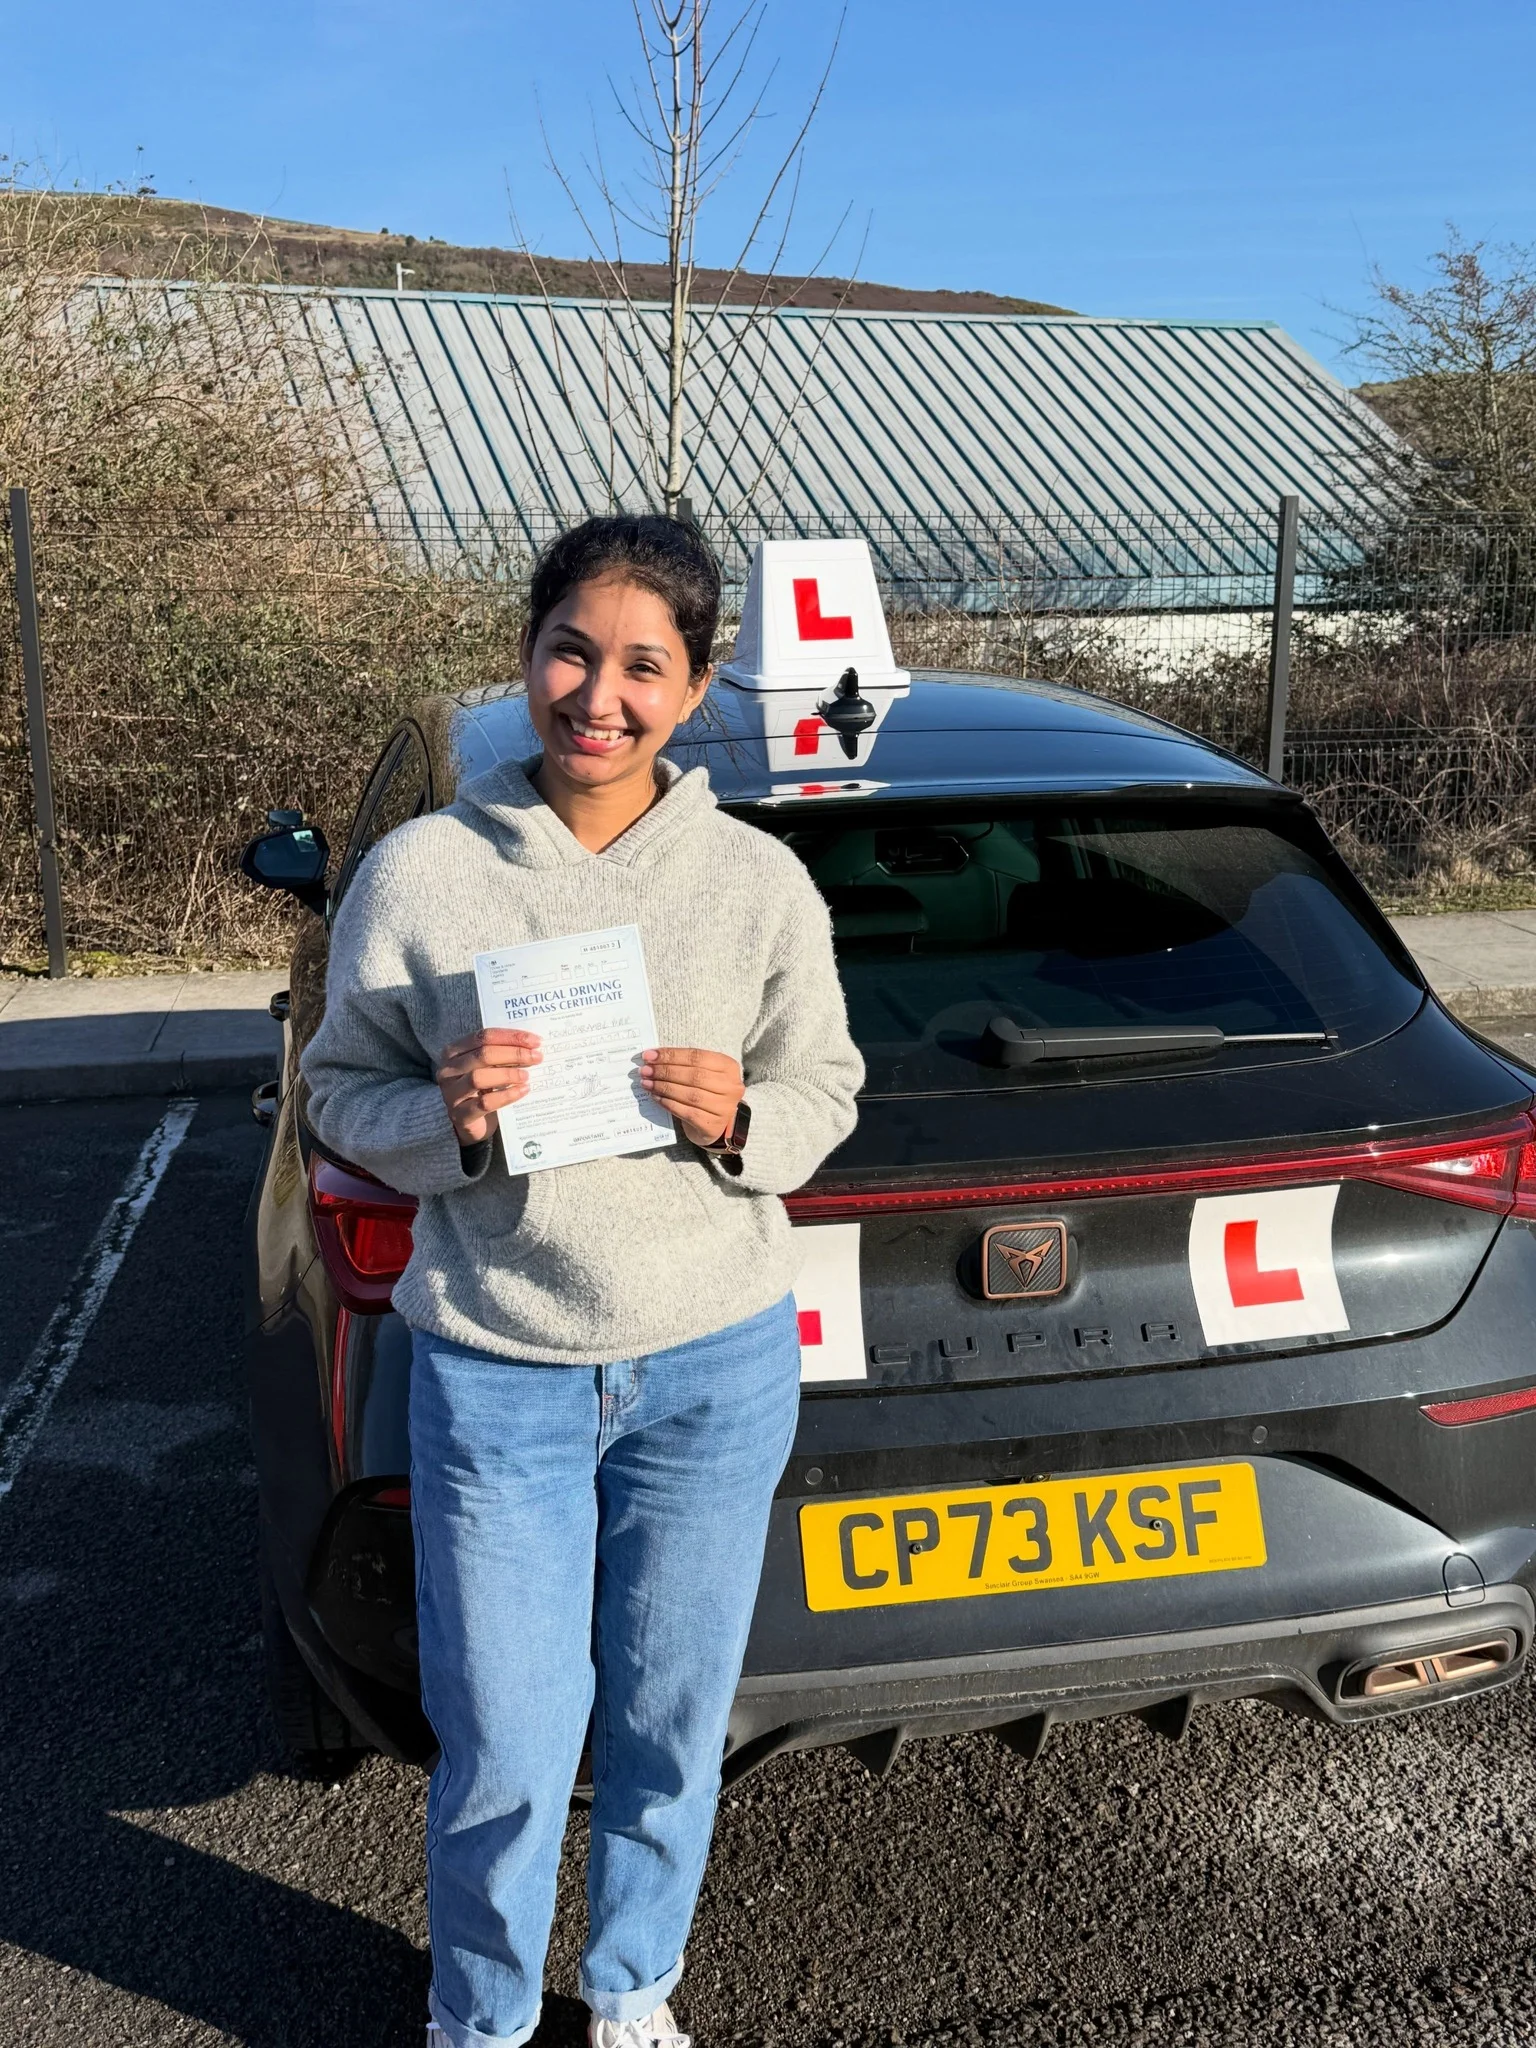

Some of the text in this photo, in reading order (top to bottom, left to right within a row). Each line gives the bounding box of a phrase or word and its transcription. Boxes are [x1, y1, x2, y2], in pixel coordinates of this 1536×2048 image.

[793, 578, 853, 641] L
[504, 979, 622, 1009] PRACTICAL DRIVING
[506, 990, 623, 1020] TEST PASS CERTIFICATE
[1224, 1219, 1305, 1308] L
[869, 1321, 1182, 1366] CUPRA
[838, 1479, 1223, 1591] CP73 KSF
[984, 1581, 1010, 1590] Sinclair
[1012, 1579, 1033, 1588] Group
[1034, 1577, 1064, 1585] Swansea
